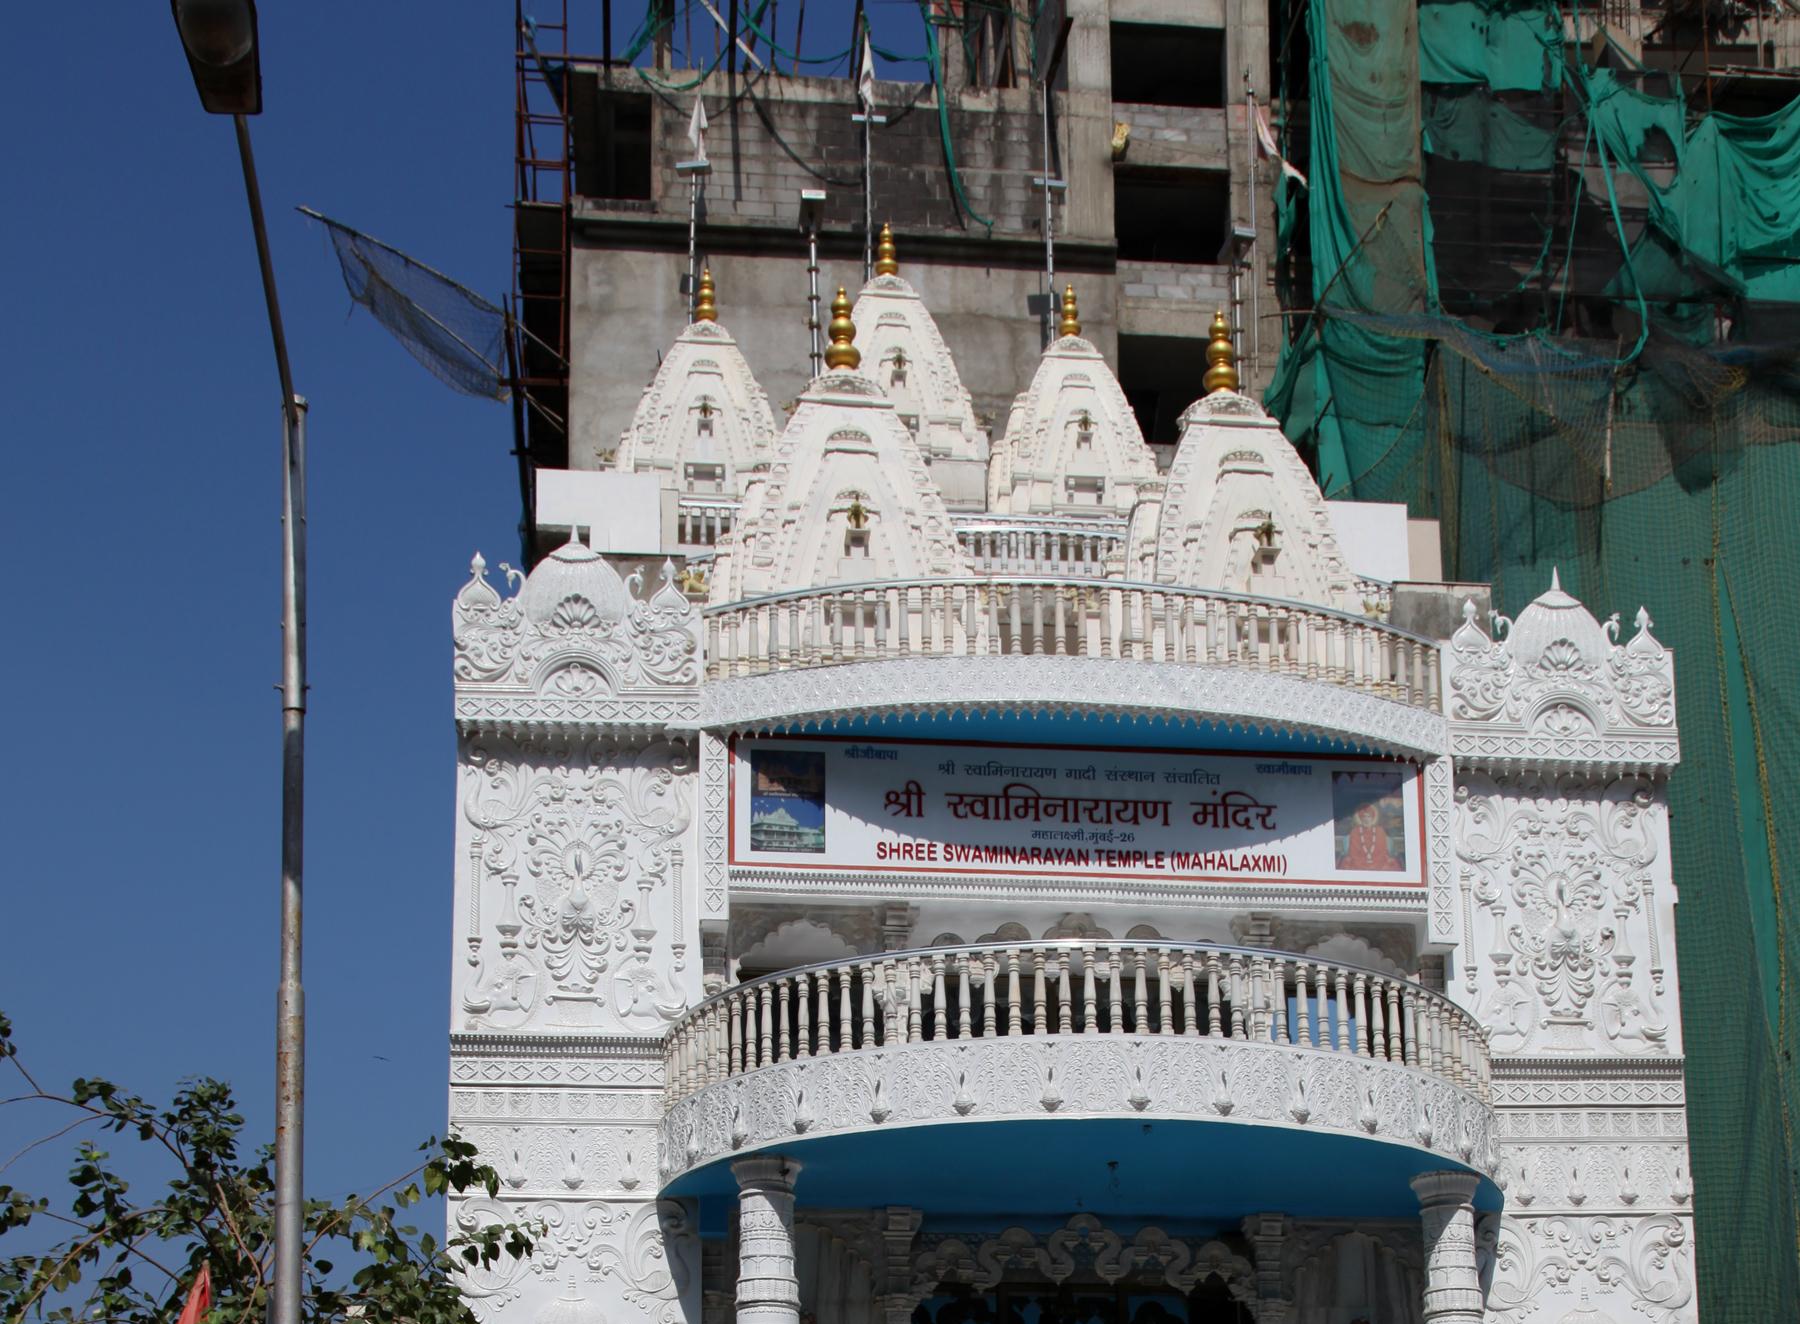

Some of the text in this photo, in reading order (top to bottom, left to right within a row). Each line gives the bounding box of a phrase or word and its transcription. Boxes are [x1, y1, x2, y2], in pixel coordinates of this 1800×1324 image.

[938, 760, 1221, 785] श्री स्वामिनारायण गादी संस्थान संचालित
[884, 780, 1278, 830] श्री स्वामिनारायण मंदिर
[876, 841, 1287, 875] SHREE SWAMINARAYAN TEMPLE (MAHALAXMI)
